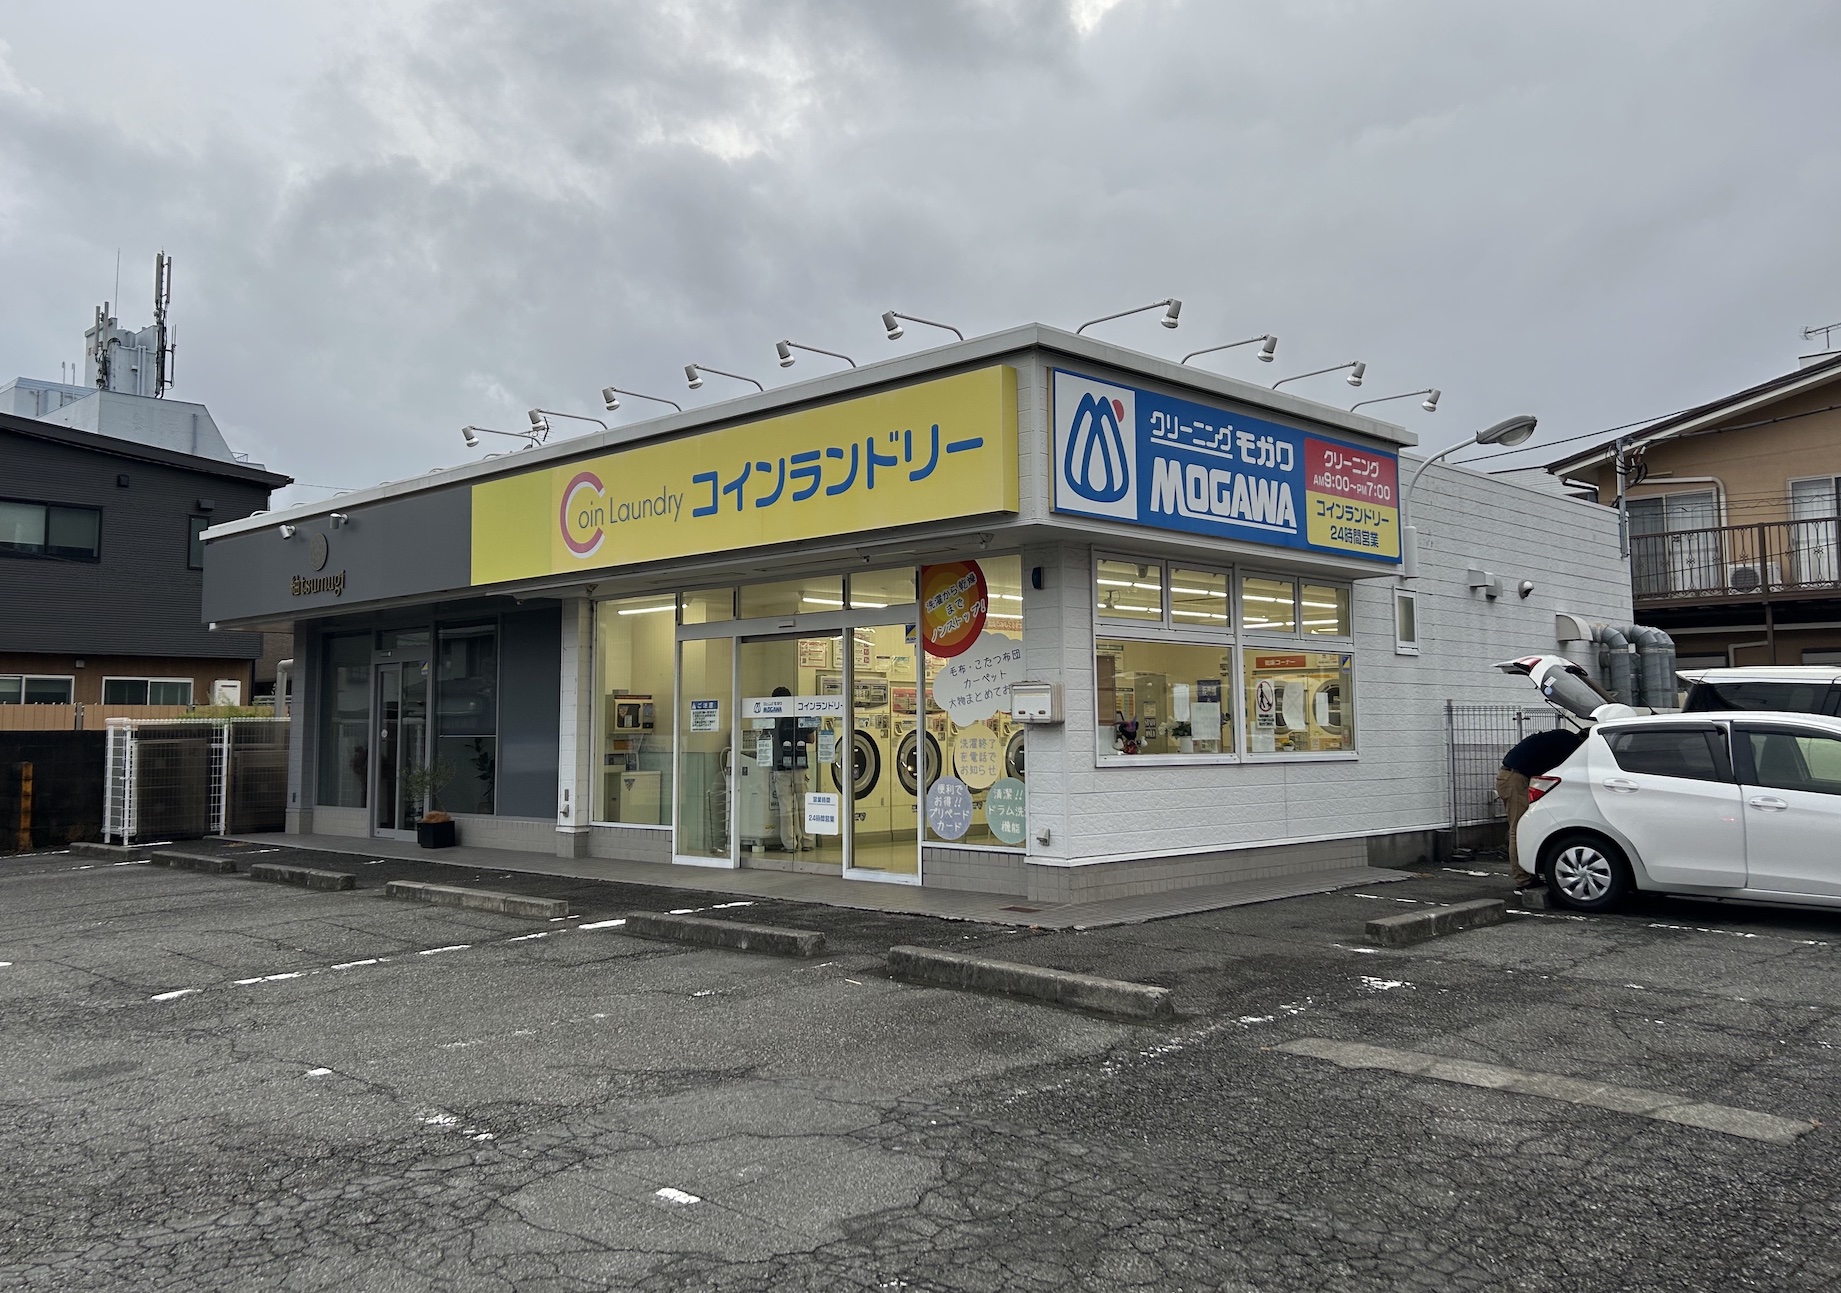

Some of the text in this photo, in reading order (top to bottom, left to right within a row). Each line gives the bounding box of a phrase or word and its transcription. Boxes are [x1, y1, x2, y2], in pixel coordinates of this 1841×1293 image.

[1150, 410, 1295, 472] クリーニング モガワ
[692, 424, 984, 518] コインランドリー
[1324, 450, 1379, 478] クリーニング
[1150, 456, 1298, 528] MOGAWA
[610, 486, 684, 524] Laundry
[1316, 500, 1390, 526] コインランドリー
[1330, 525, 1379, 548] 24時間営業
[925, 571, 977, 613] 洗濯から乾燥
[946, 597, 964, 616] まで
[964, 669, 1007, 689] カーペット
[798, 701, 843, 711] コインランドリ
[960, 738, 997, 749] 洗濯終了
[960, 752, 997, 762] を電話で
[960, 765, 997, 775] お知らせ
[937, 784, 963, 795] 便利で
[988, 805, 1026, 818] ドラム洗
[937, 821, 962, 832] カード
[1001, 821, 1020, 834] 機能
